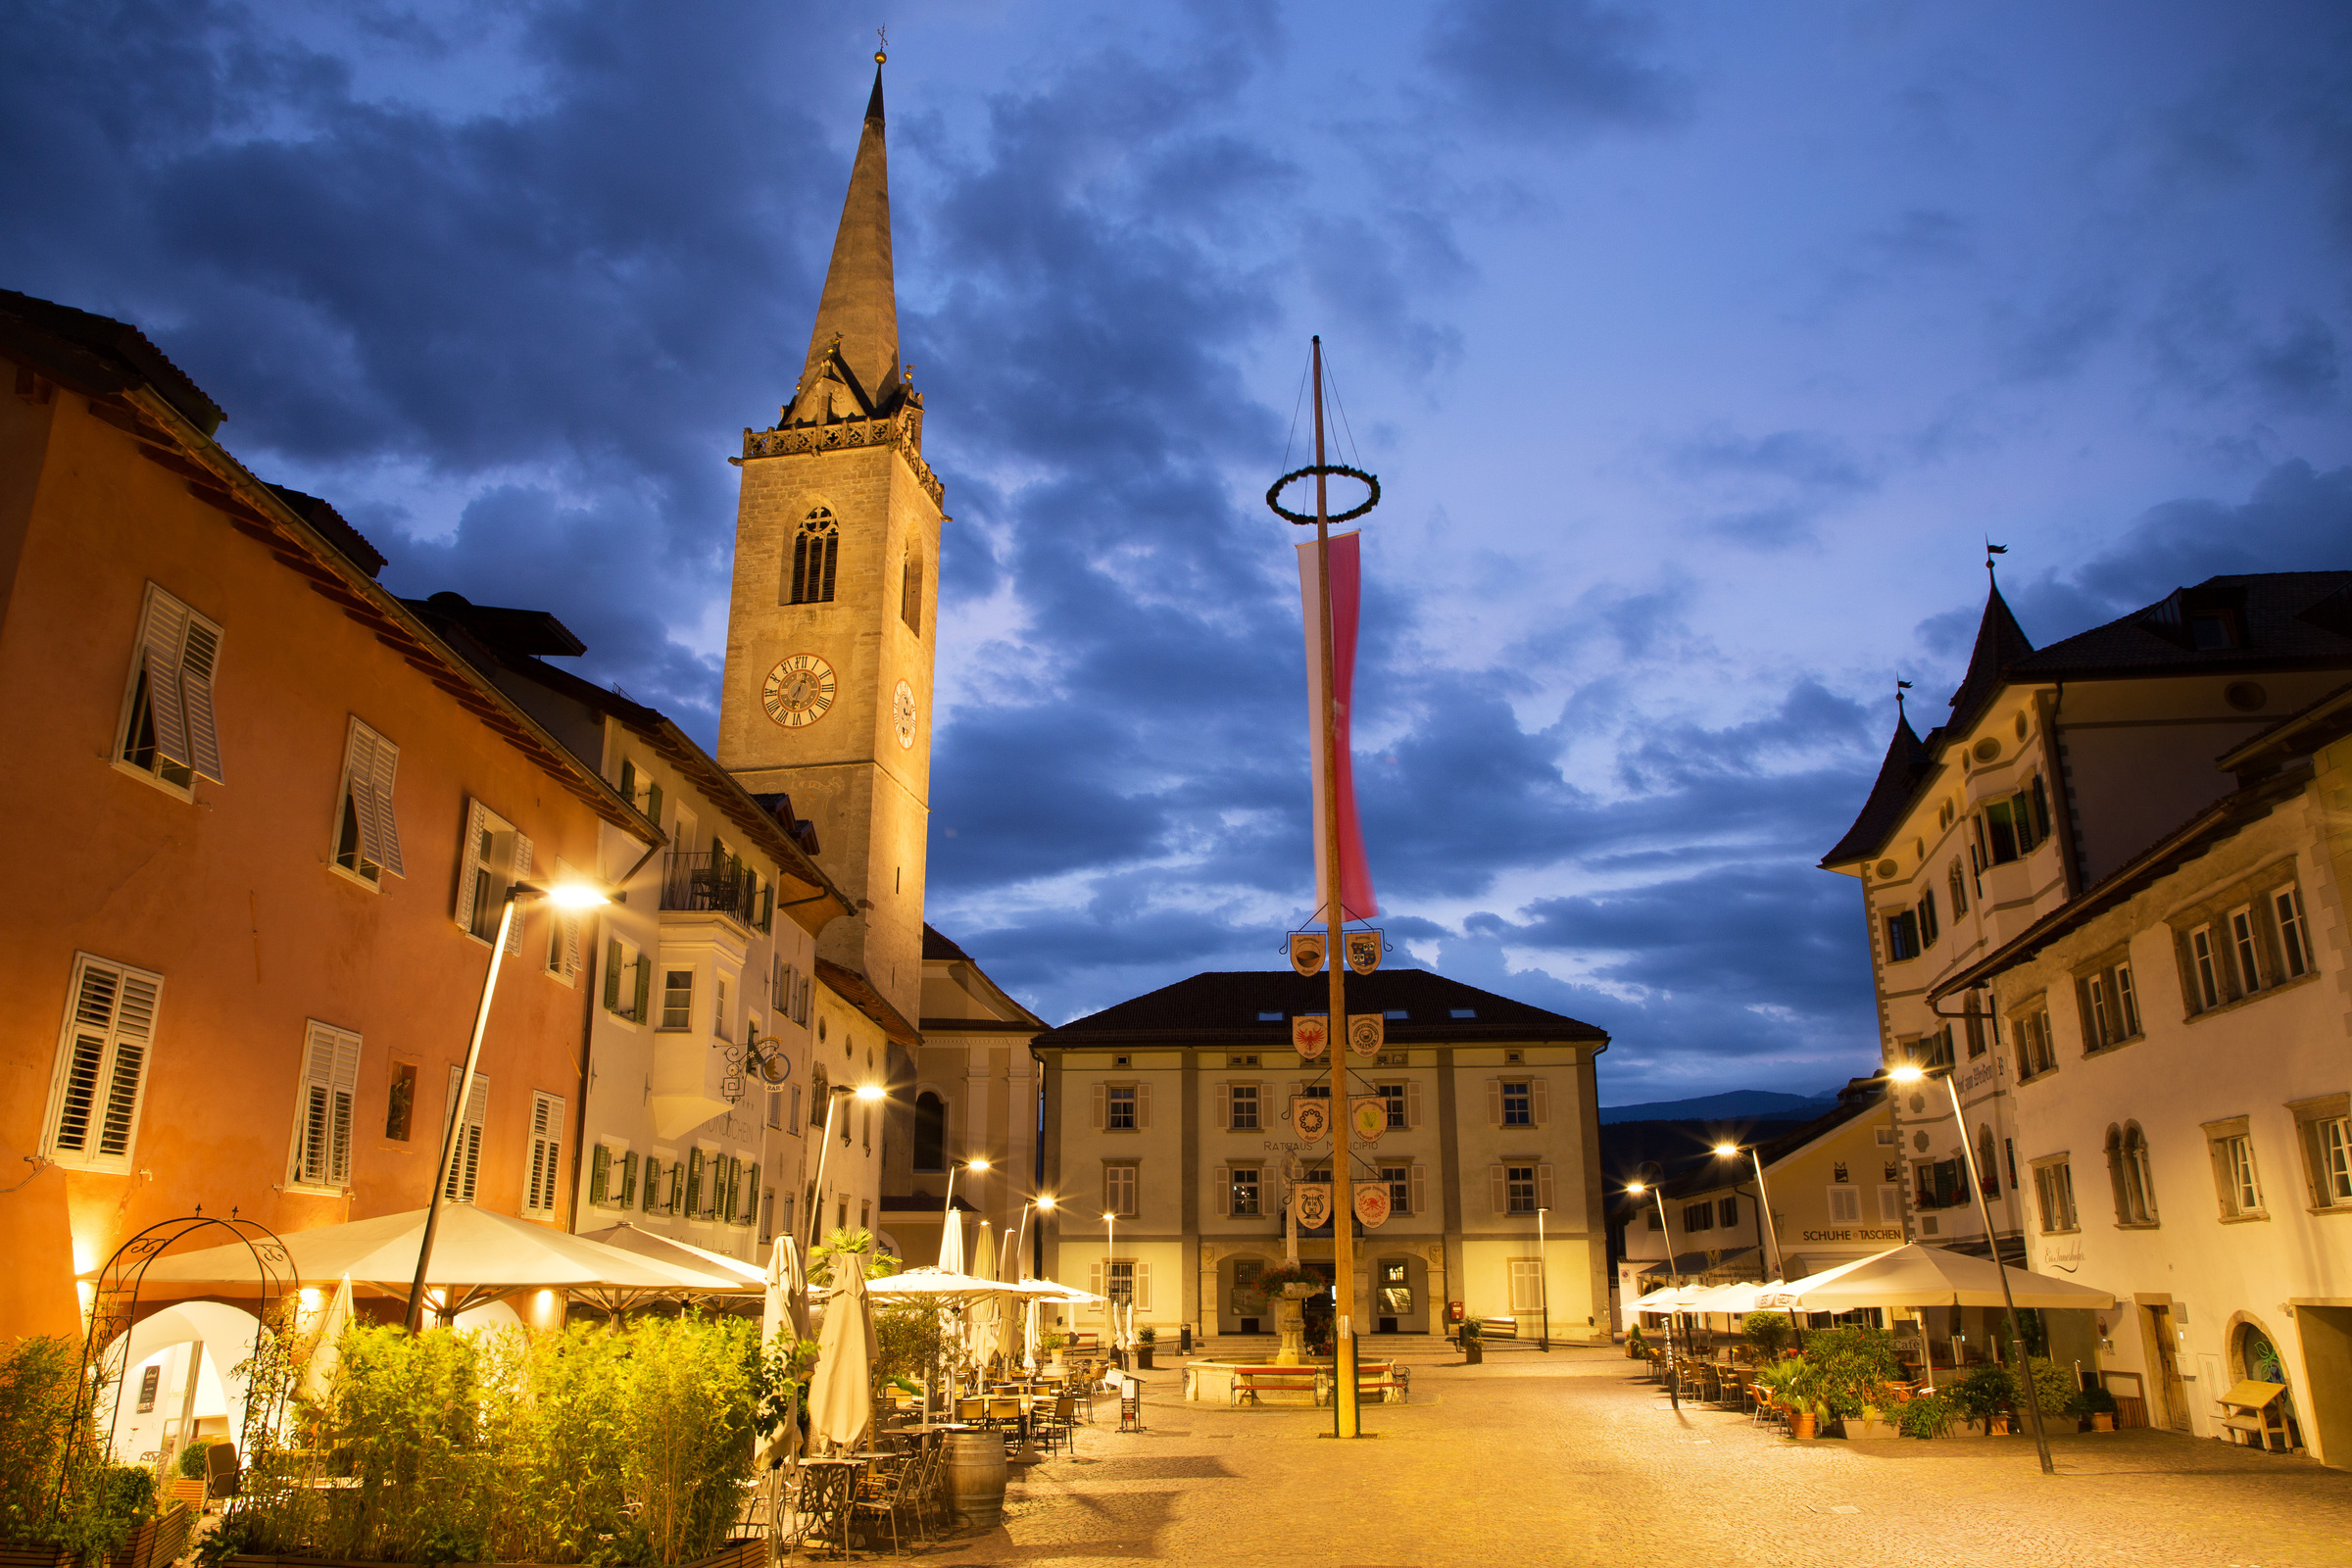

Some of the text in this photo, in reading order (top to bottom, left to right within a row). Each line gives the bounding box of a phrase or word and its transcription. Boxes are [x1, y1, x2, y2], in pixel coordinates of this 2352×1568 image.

[1326, 1141, 1379, 1151] MICIPIO
[1803, 1229, 1901, 1242] SCHUHE TASCHEN
[1664, 1320, 1675, 1371] RESTAURANT
